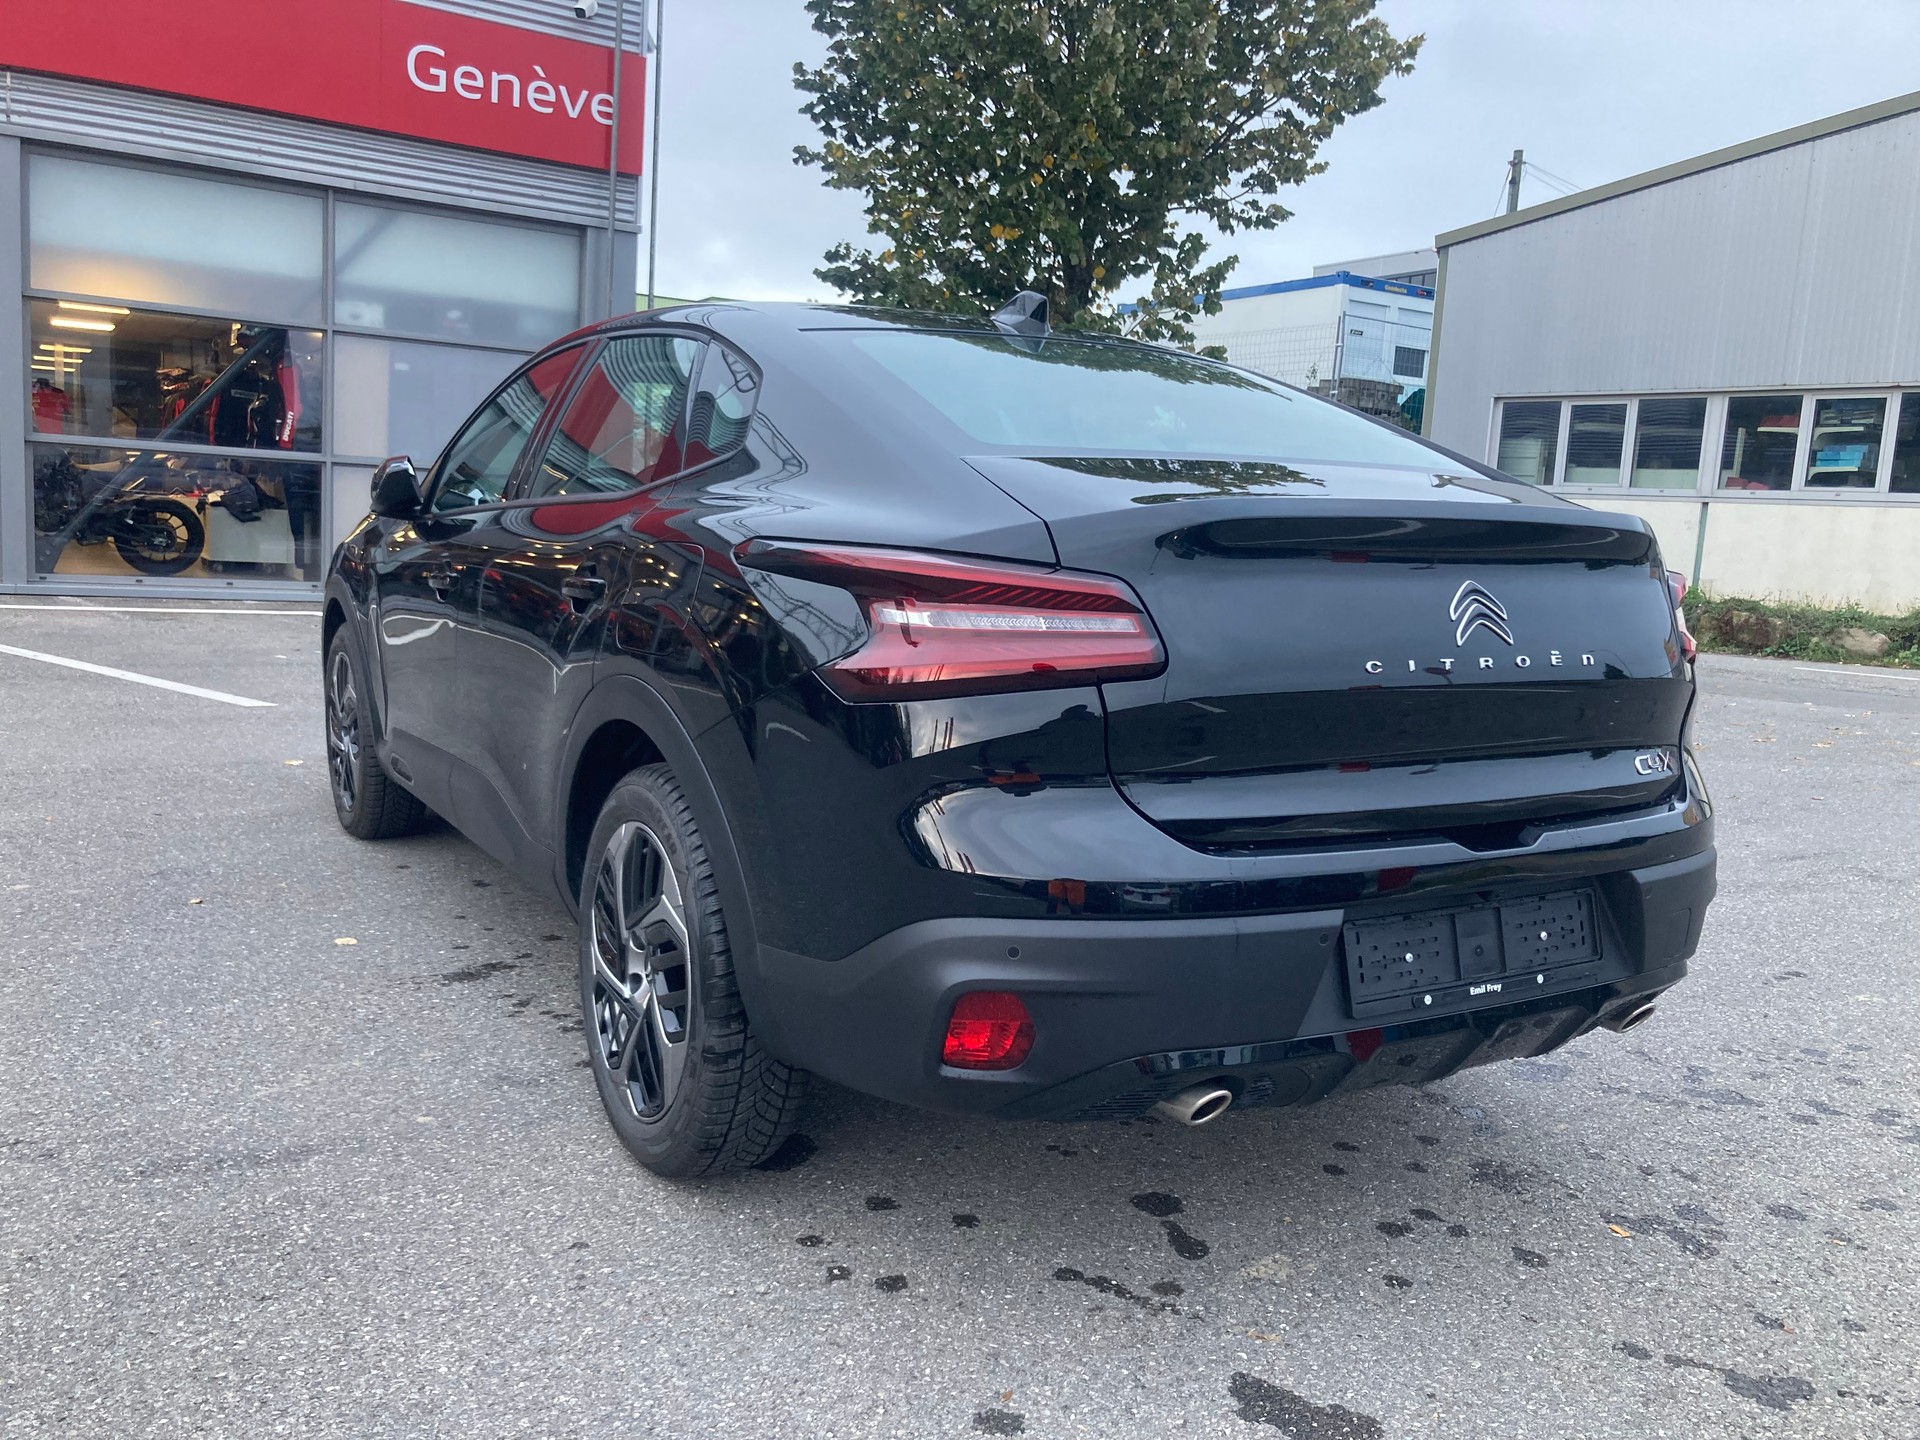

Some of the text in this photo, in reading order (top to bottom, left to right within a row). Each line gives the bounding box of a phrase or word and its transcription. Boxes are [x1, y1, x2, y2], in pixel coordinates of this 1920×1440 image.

[407, 44, 613, 126] Genève
[282, 411, 294, 442] DUCATI
[1470, 983, 1502, 996] Emil Frey
